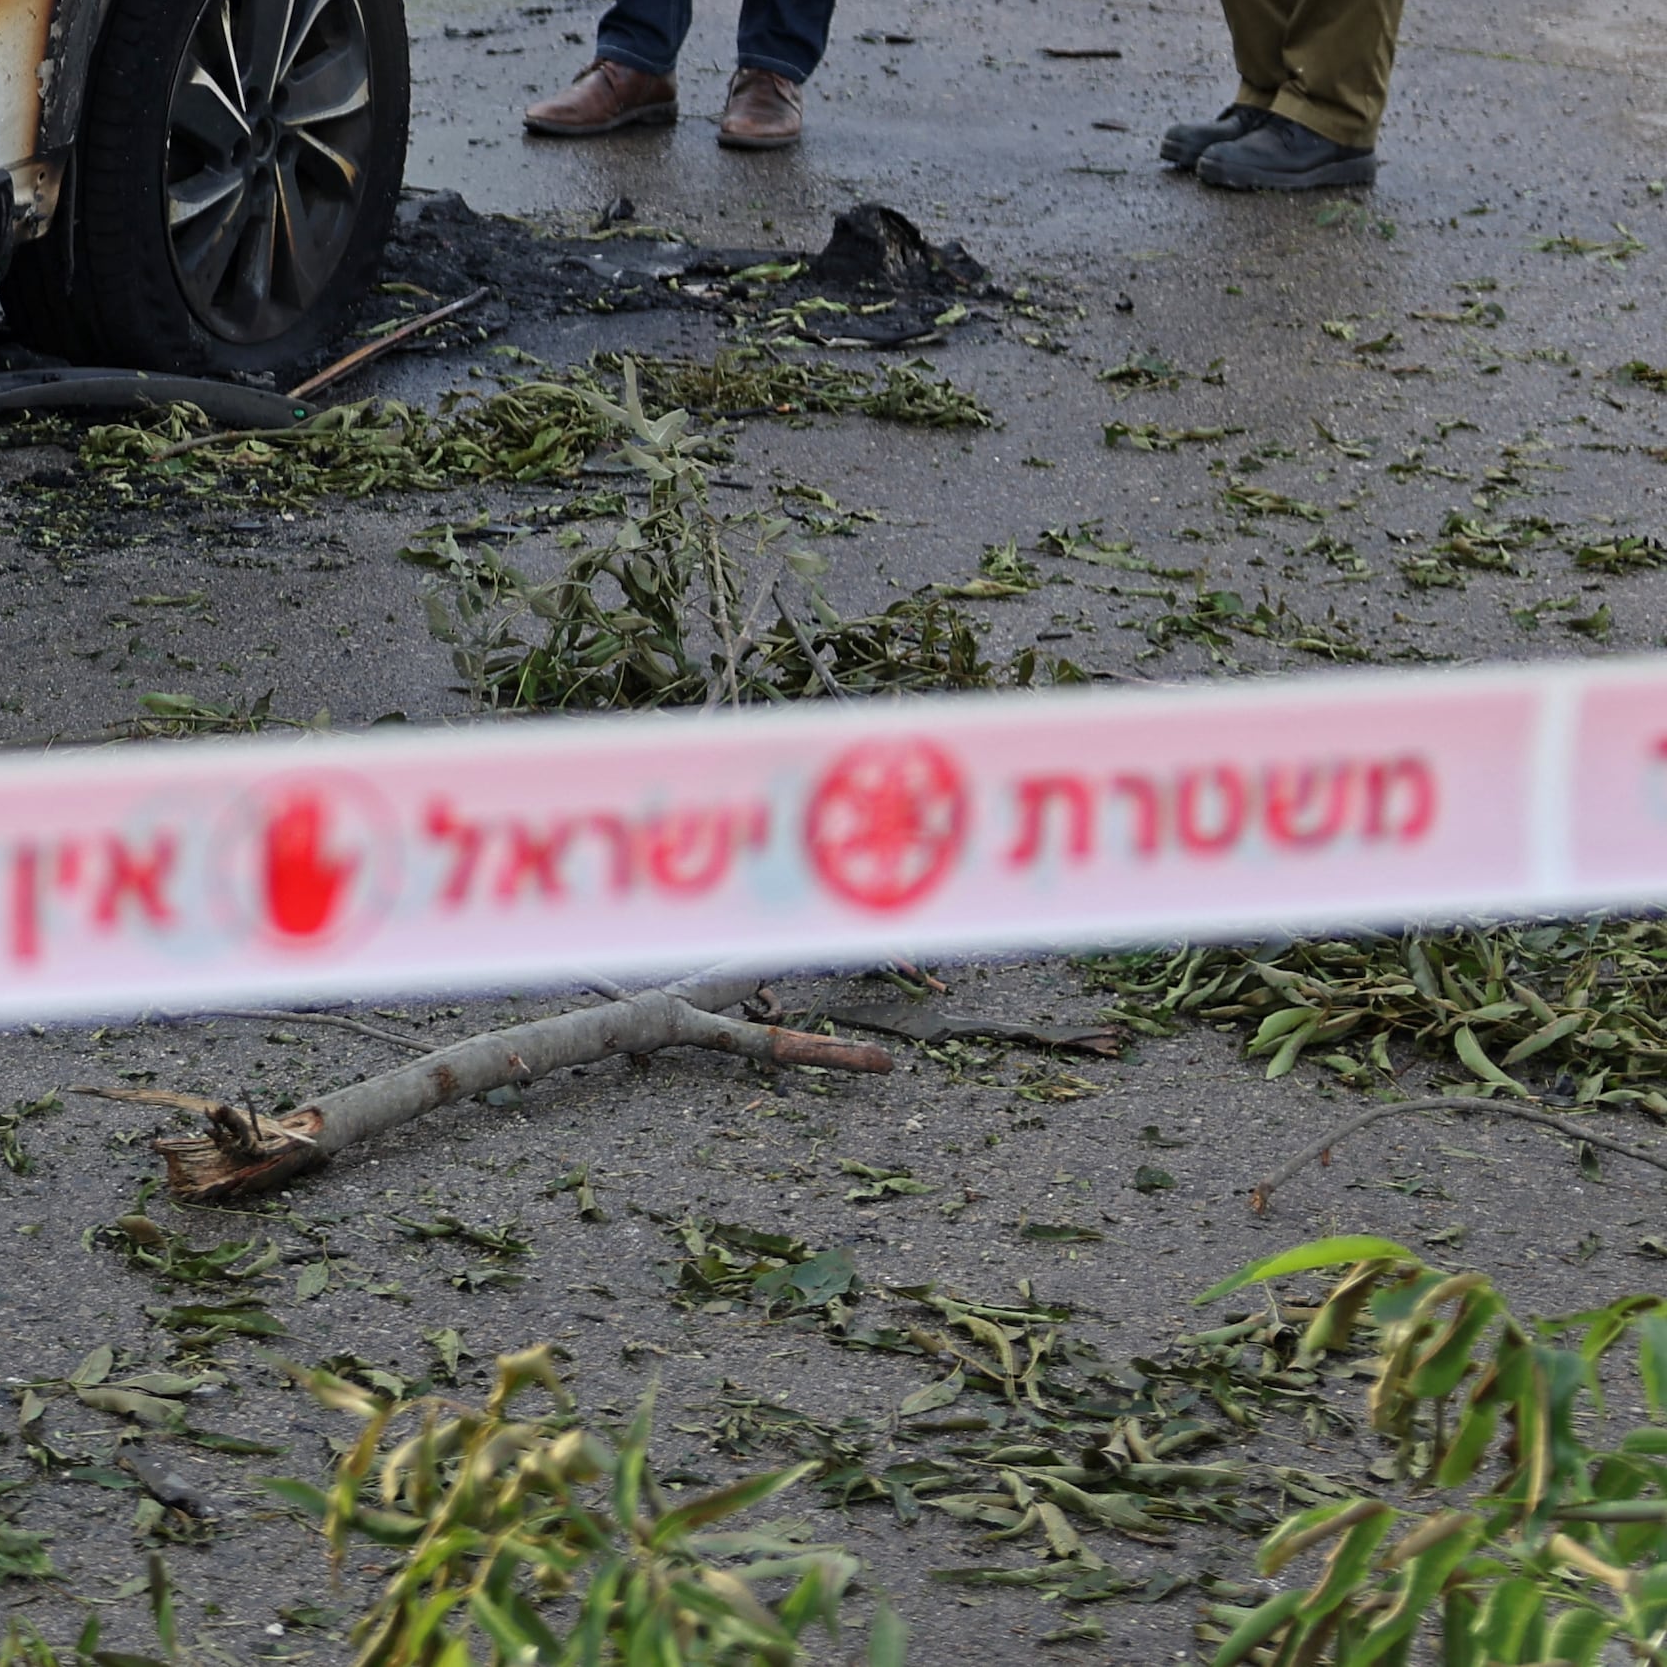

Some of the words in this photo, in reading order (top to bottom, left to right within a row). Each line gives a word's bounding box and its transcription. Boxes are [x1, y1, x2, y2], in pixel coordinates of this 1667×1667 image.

[422, 796, 769, 910] ישראל
[1007, 754, 1438, 868] משטרת
[8, 824, 175, 964] אין
